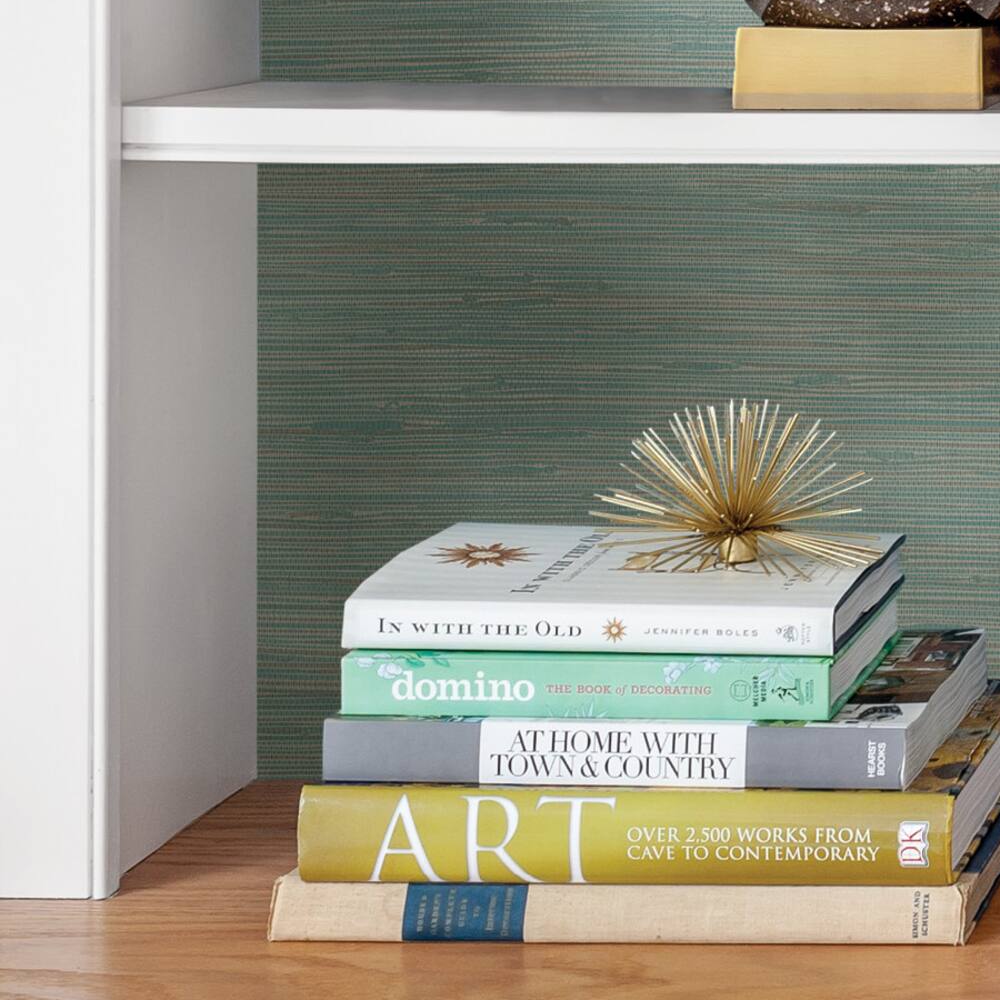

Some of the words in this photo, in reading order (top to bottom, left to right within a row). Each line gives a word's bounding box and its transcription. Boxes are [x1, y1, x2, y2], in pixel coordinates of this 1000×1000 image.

[644, 627, 709, 636] JENNIFER
[716, 629, 759, 637] BOLES
[391, 670, 536, 701] domino
[546, 685, 572, 694] THE
[576, 685, 612, 695] BOOK
[616, 685, 627, 697] of
[631, 685, 712, 696] DECORATING
[509, 729, 545, 753] AT
[549, 730, 632, 754] HOME
[640, 731, 719, 755] WITH
[490, 753, 576, 778] TOWN
[580, 755, 599, 778] &
[604, 755, 737, 780] COUNTRY
[868, 740, 877, 778] HEARST
[877, 742, 887, 777] BOOKS
[367, 793, 617, 883] ART
[626, 826, 680, 843] OVER
[685, 827, 731, 844] 2,500
[737, 827, 808, 844] WORKS
[815, 827, 873, 844] FROM
[901, 825, 923, 863] DK
[626, 845, 675, 861] CAVE
[682, 845, 709, 861] TO
[715, 846, 880, 862] CONTEMPORARY
[921, 893, 930, 936] SCHUSTER
